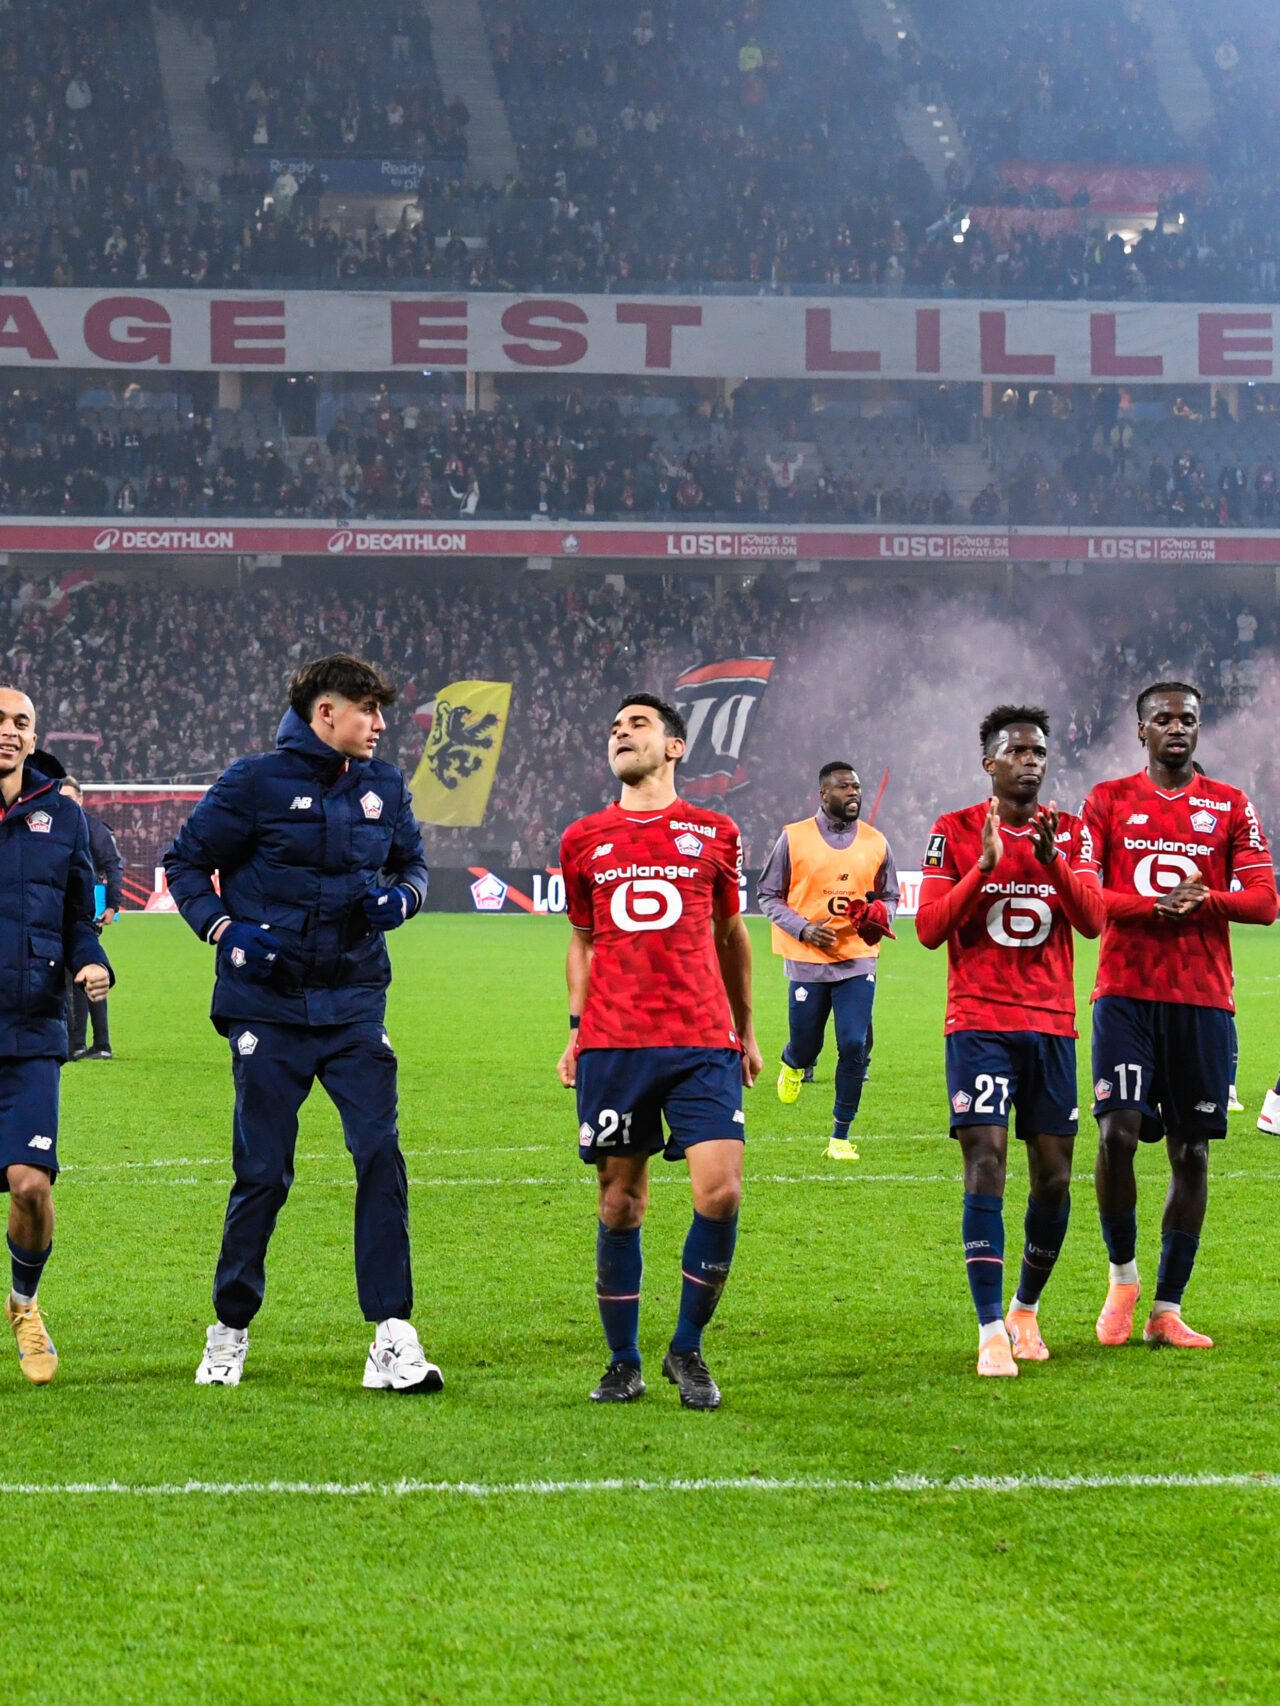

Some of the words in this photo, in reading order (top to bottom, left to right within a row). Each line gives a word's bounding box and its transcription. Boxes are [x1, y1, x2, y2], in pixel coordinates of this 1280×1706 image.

[381, 161, 425, 177] Ready
[390, 300, 703, 369] EST
[805, 307, 1274, 376] LILLE
[122, 531, 233, 549] DECATHLON
[355, 533, 466, 551] DECATHLON
[667, 534, 732, 555] LOSC
[783, 536, 797, 546] DE
[880, 536, 944, 556] LOSC
[995, 537, 1009, 547] DE
[1088, 539, 1151, 559] LOSC
[1201, 540, 1215, 550] DE
[741, 545, 797, 556] DOTATION
[953, 548, 1009, 557] DOTATION
[1160, 550, 1215, 560] DOTATION
[1188, 796, 1231, 811] actual
[670, 820, 717, 839] actual
[1124, 837, 1215, 857] boulanger
[594, 864, 699, 885] boulanger
[981, 880, 1057, 897] oulange
[1114, 1063, 1143, 1101] 17
[974, 1073, 1009, 1115] 27
